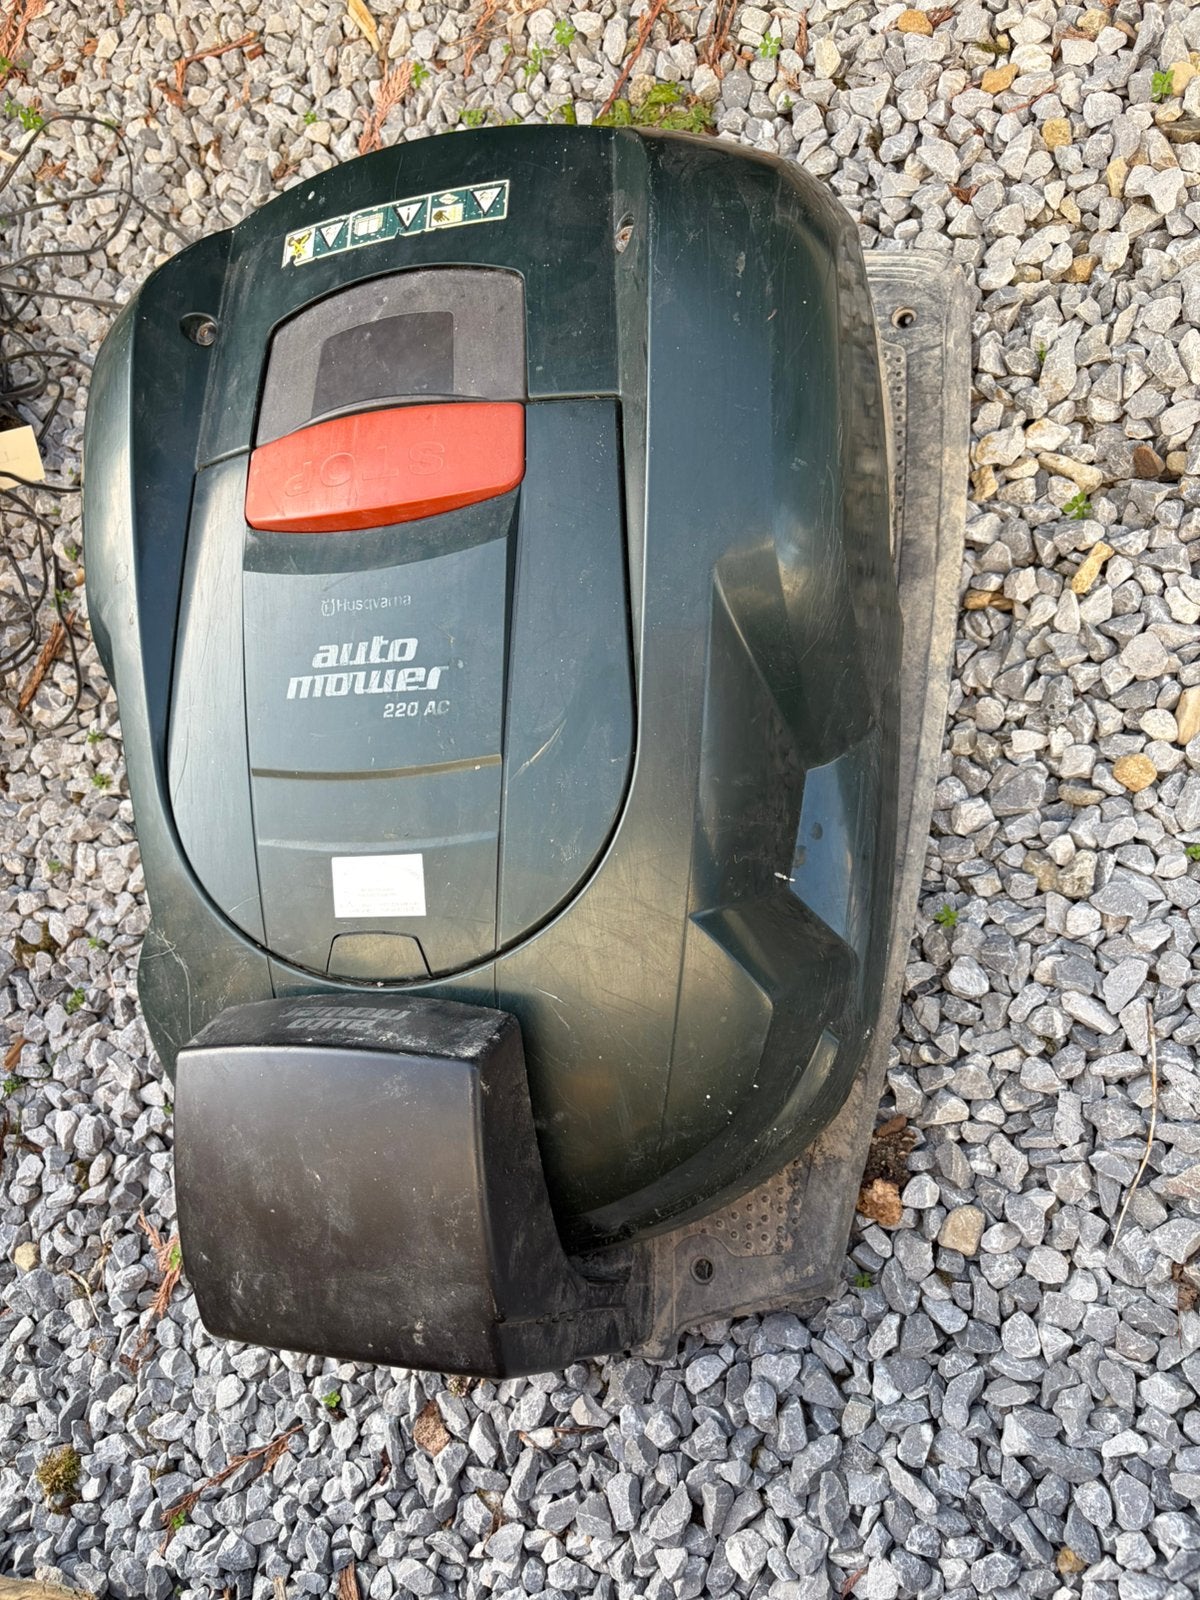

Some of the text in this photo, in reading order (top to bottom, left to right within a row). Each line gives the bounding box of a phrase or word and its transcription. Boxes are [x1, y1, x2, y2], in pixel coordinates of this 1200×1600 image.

[284, 440, 446, 498] STOP
[336, 594, 412, 613] Husqvarna
[312, 635, 419, 669] auto
[286, 666, 449, 700] mower
[383, 700, 450, 719] 220 AC
[279, 1006, 411, 1020] mower
[286, 1018, 377, 1031] auto
